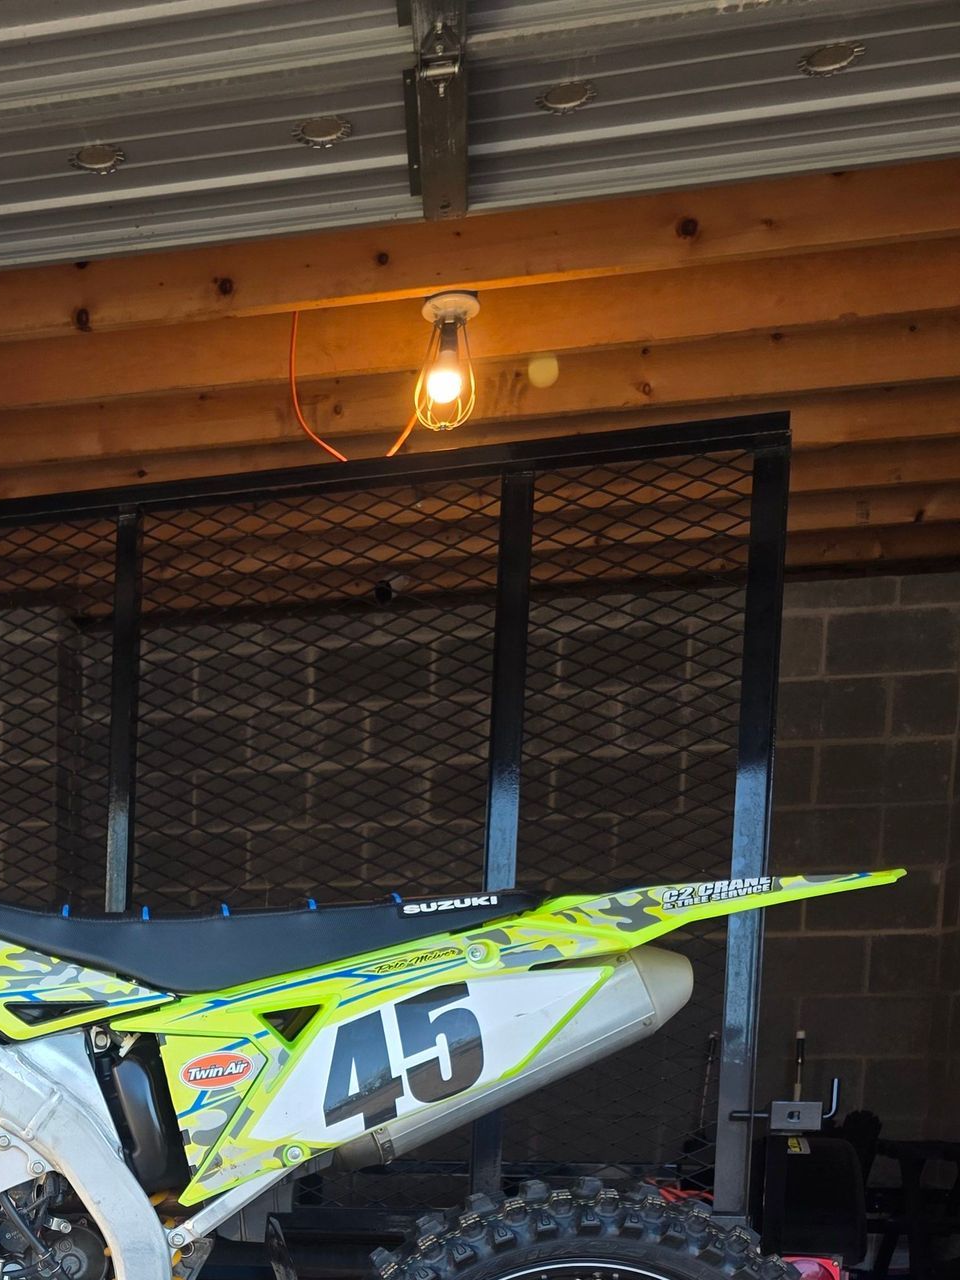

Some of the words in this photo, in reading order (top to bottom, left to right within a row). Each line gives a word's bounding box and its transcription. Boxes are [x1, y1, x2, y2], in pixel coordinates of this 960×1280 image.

[663, 887, 694, 903] C2
[698, 876, 772, 897] CRANE
[676, 895, 709, 907] TREE
[711, 883, 771, 901] SERVICE
[403, 895, 498, 914] SUZUKI
[323, 981, 485, 1131] 45
[188, 1064, 224, 1080] Twin
[223, 1061, 248, 1077] Air
